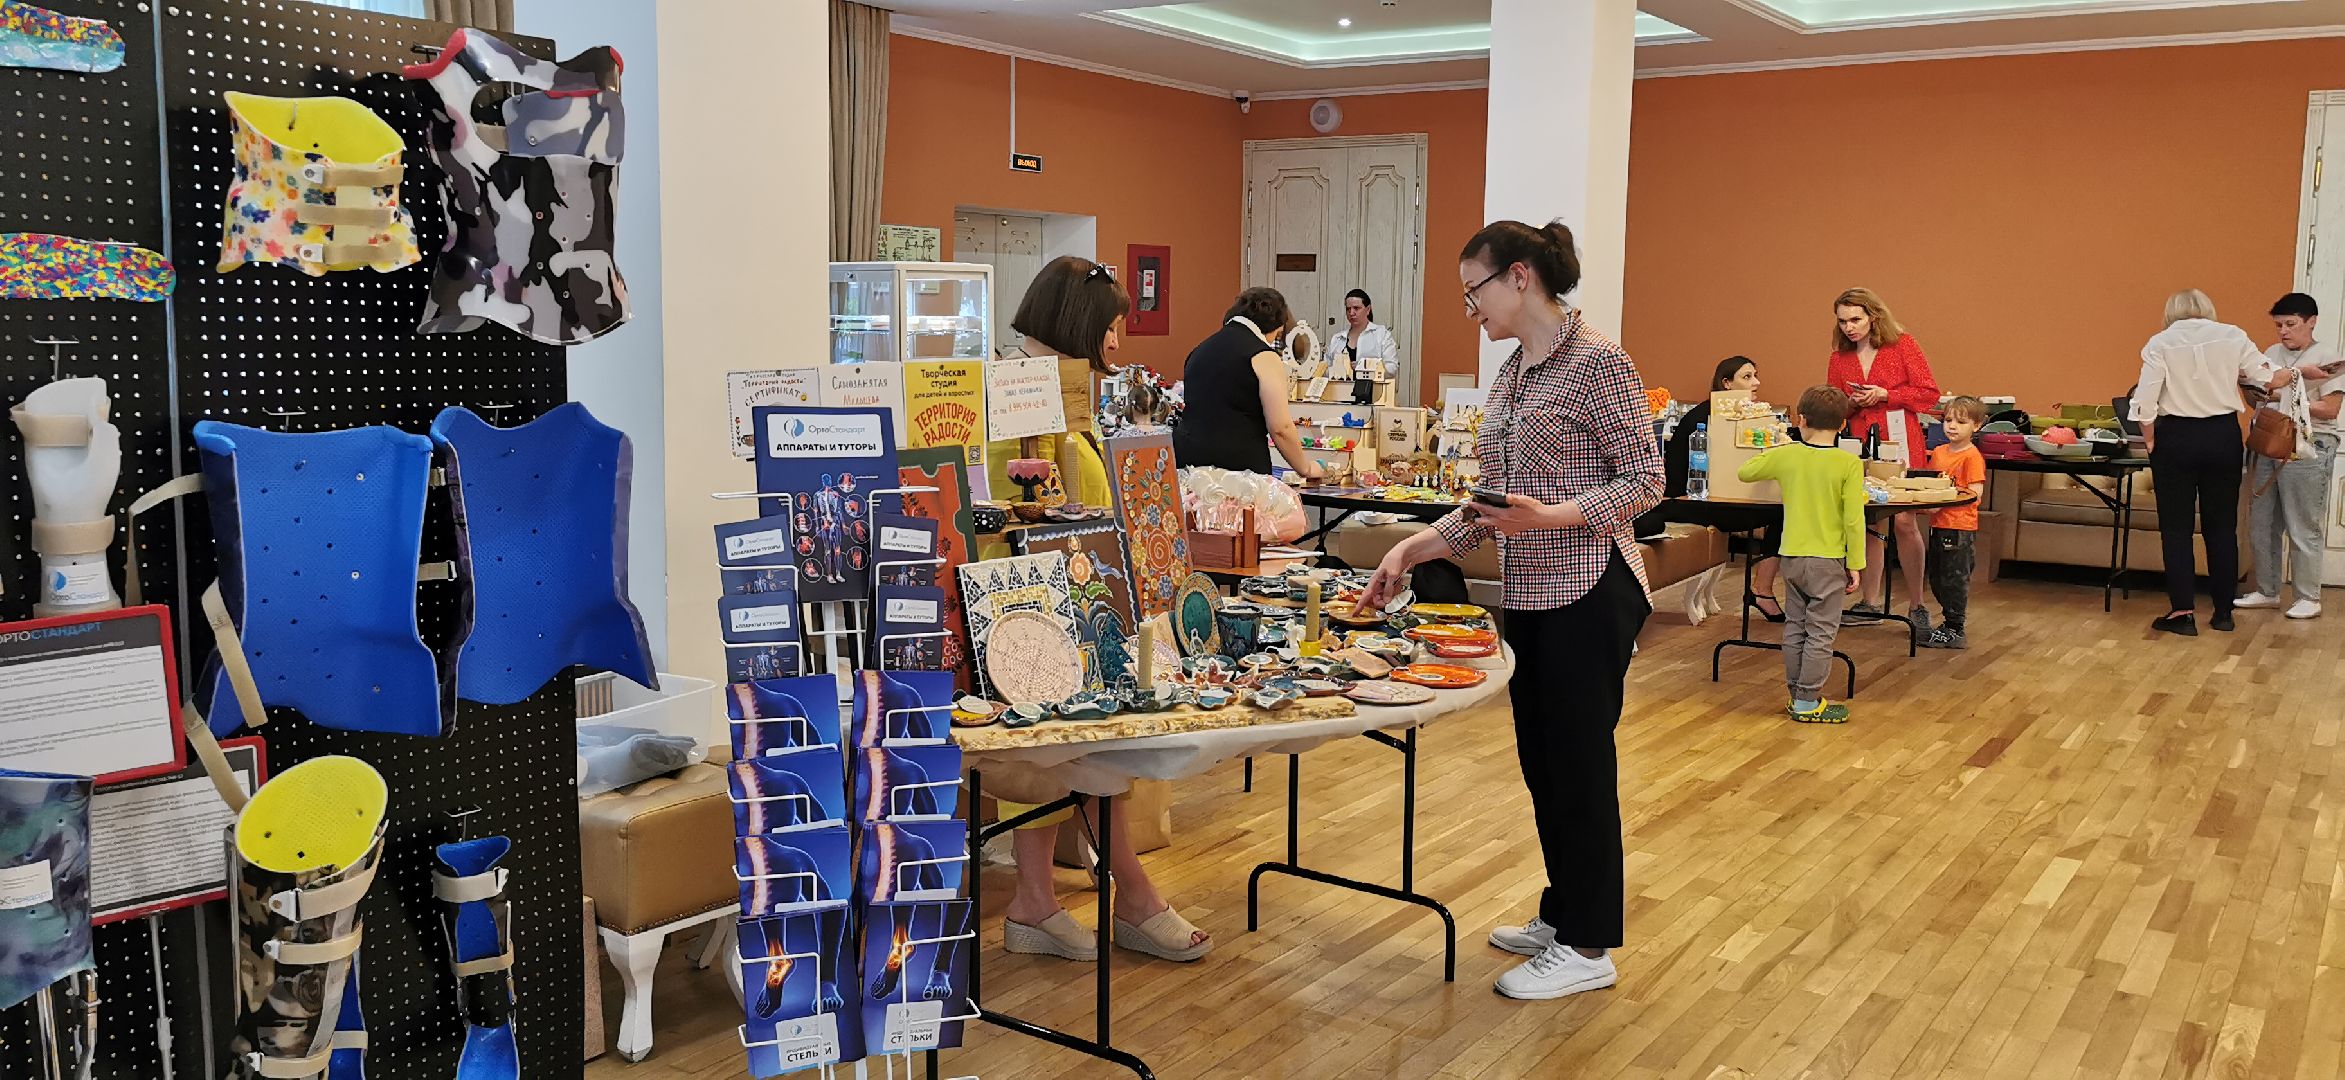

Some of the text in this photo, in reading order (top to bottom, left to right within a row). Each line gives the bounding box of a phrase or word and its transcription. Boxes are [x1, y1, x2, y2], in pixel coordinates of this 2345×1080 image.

[921, 369, 966, 379] Творческая
[931, 380, 957, 389] студия
[745, 386, 801, 407] СЕРТИФИКАТ
[926, 390, 942, 398] детей
[914, 402, 977, 432] ТЕРРИТОРИЯ
[808, 424, 866, 435] ОртоСтандарт
[923, 421, 971, 448] РАДОСТИ
[776, 443, 877, 452] АППАРАТЫ И ТУТОРЫ
[0, 622, 102, 644] РТОСТАНДАРТ
[787, 1046, 832, 1063] СТЕЛЬИ
